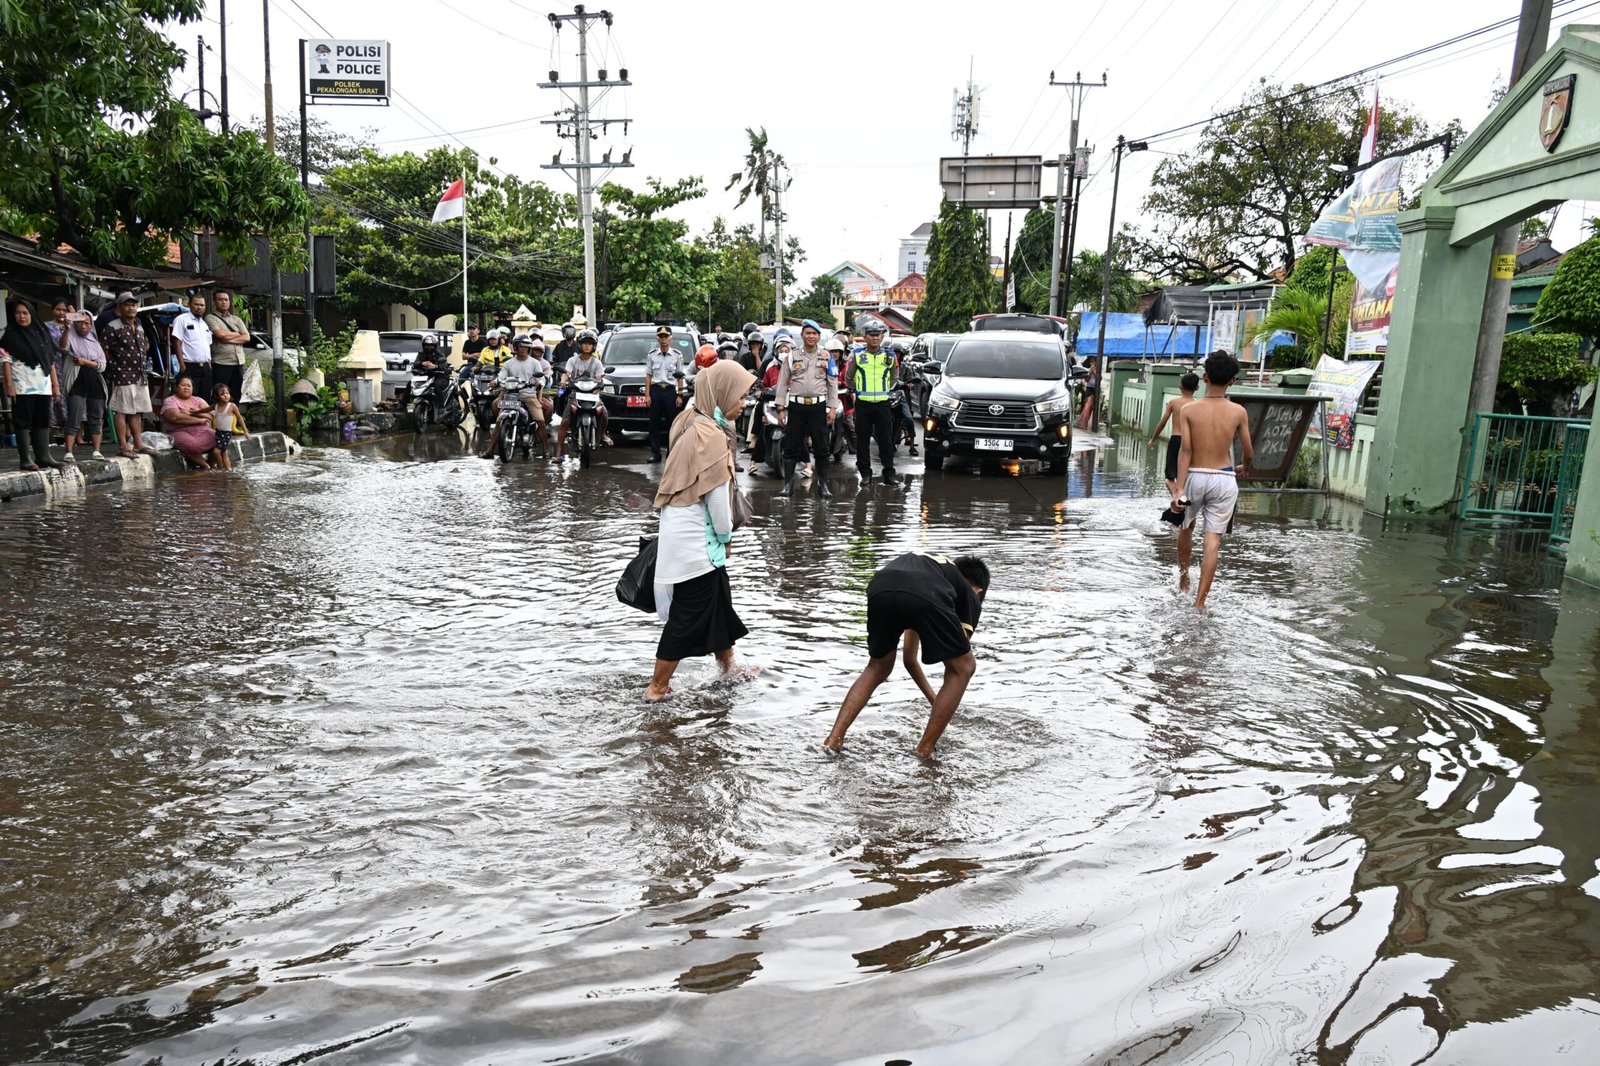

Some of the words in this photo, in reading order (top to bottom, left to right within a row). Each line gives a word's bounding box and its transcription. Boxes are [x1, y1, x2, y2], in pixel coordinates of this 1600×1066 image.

[336, 46, 381, 57] POLISI
[336, 64, 381, 74] POLICE
[1263, 424, 1292, 438] KOTA
[1262, 440, 1288, 454] PKL
